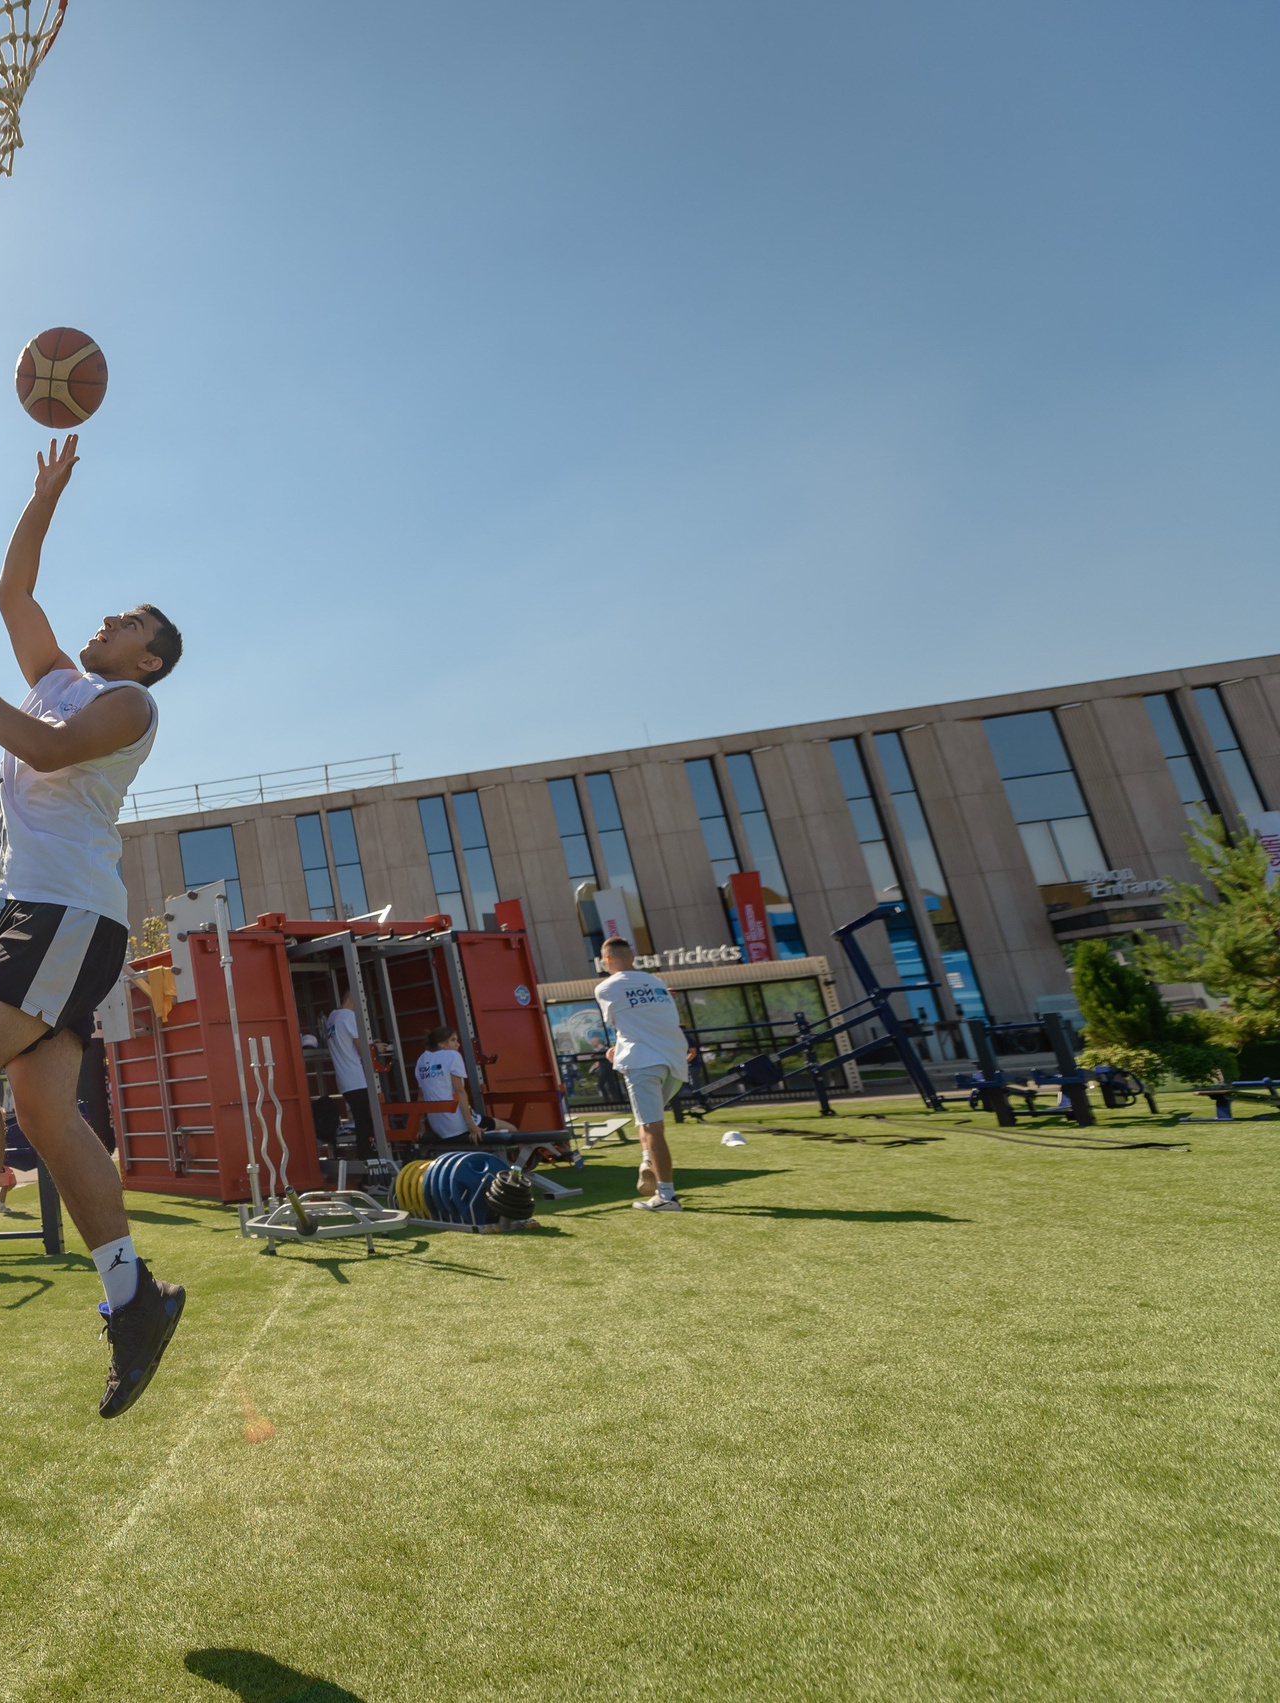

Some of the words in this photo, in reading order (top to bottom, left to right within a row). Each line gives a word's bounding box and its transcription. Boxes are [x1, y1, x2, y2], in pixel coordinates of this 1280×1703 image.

[1086, 879, 1174, 898] Entranc
[594, 955, 661, 974] Ксы
[664, 944, 741, 966] Tickets
[625, 983, 654, 999] мой
